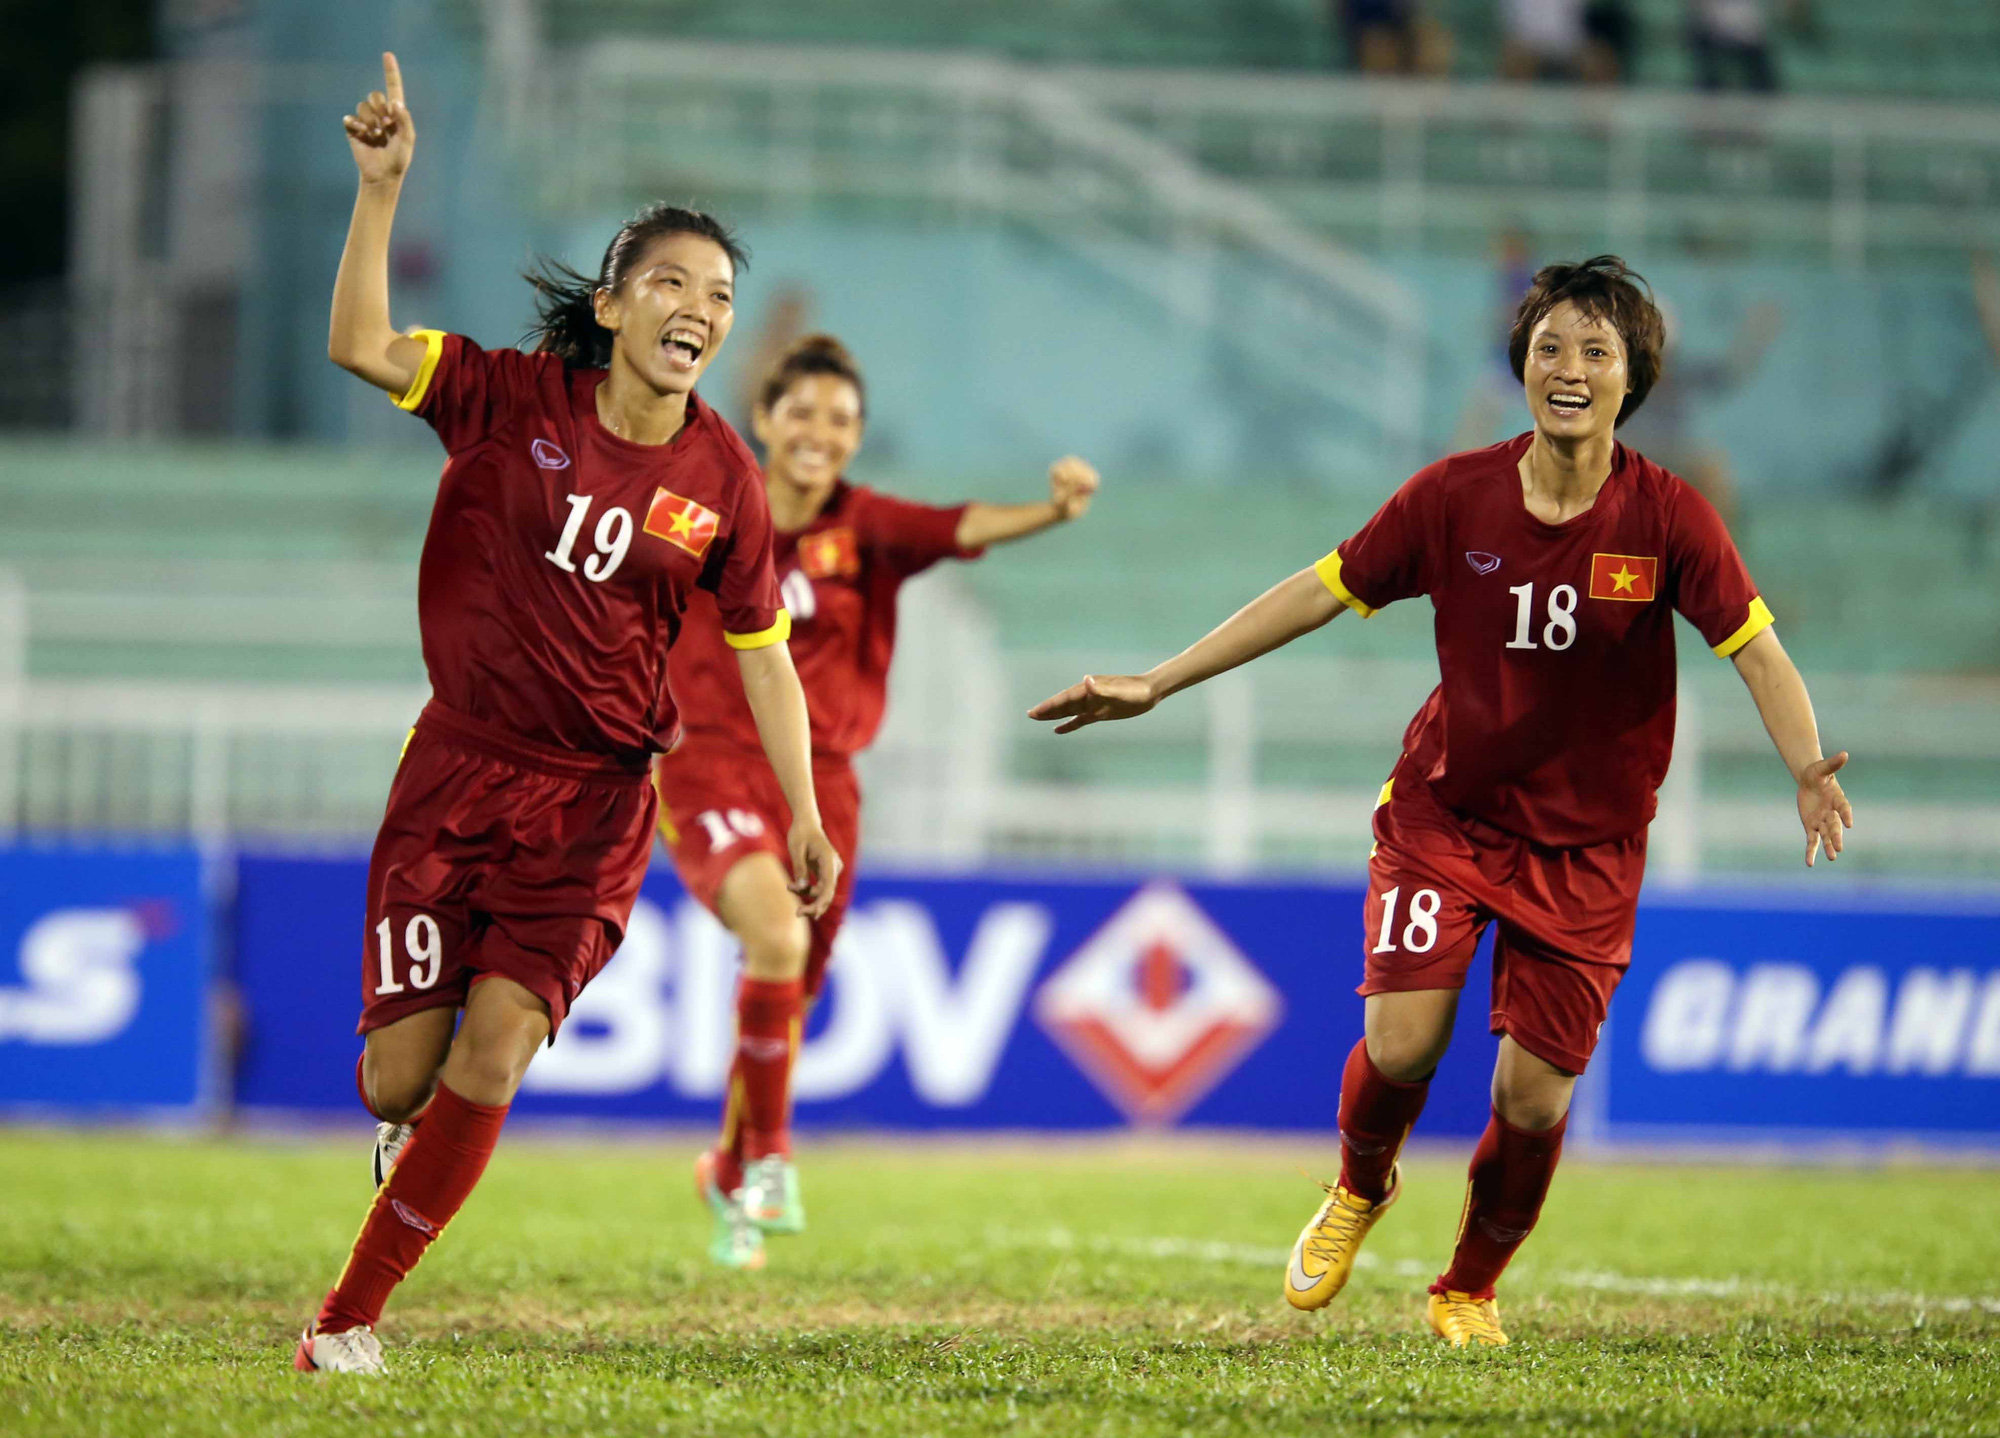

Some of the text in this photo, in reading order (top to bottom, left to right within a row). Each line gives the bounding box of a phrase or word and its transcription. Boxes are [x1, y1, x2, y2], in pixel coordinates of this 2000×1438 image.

[545, 494, 633, 581] 19
[1506, 582, 1577, 650] 18
[376, 915, 440, 994] 19
[1372, 886, 1441, 954] 18
